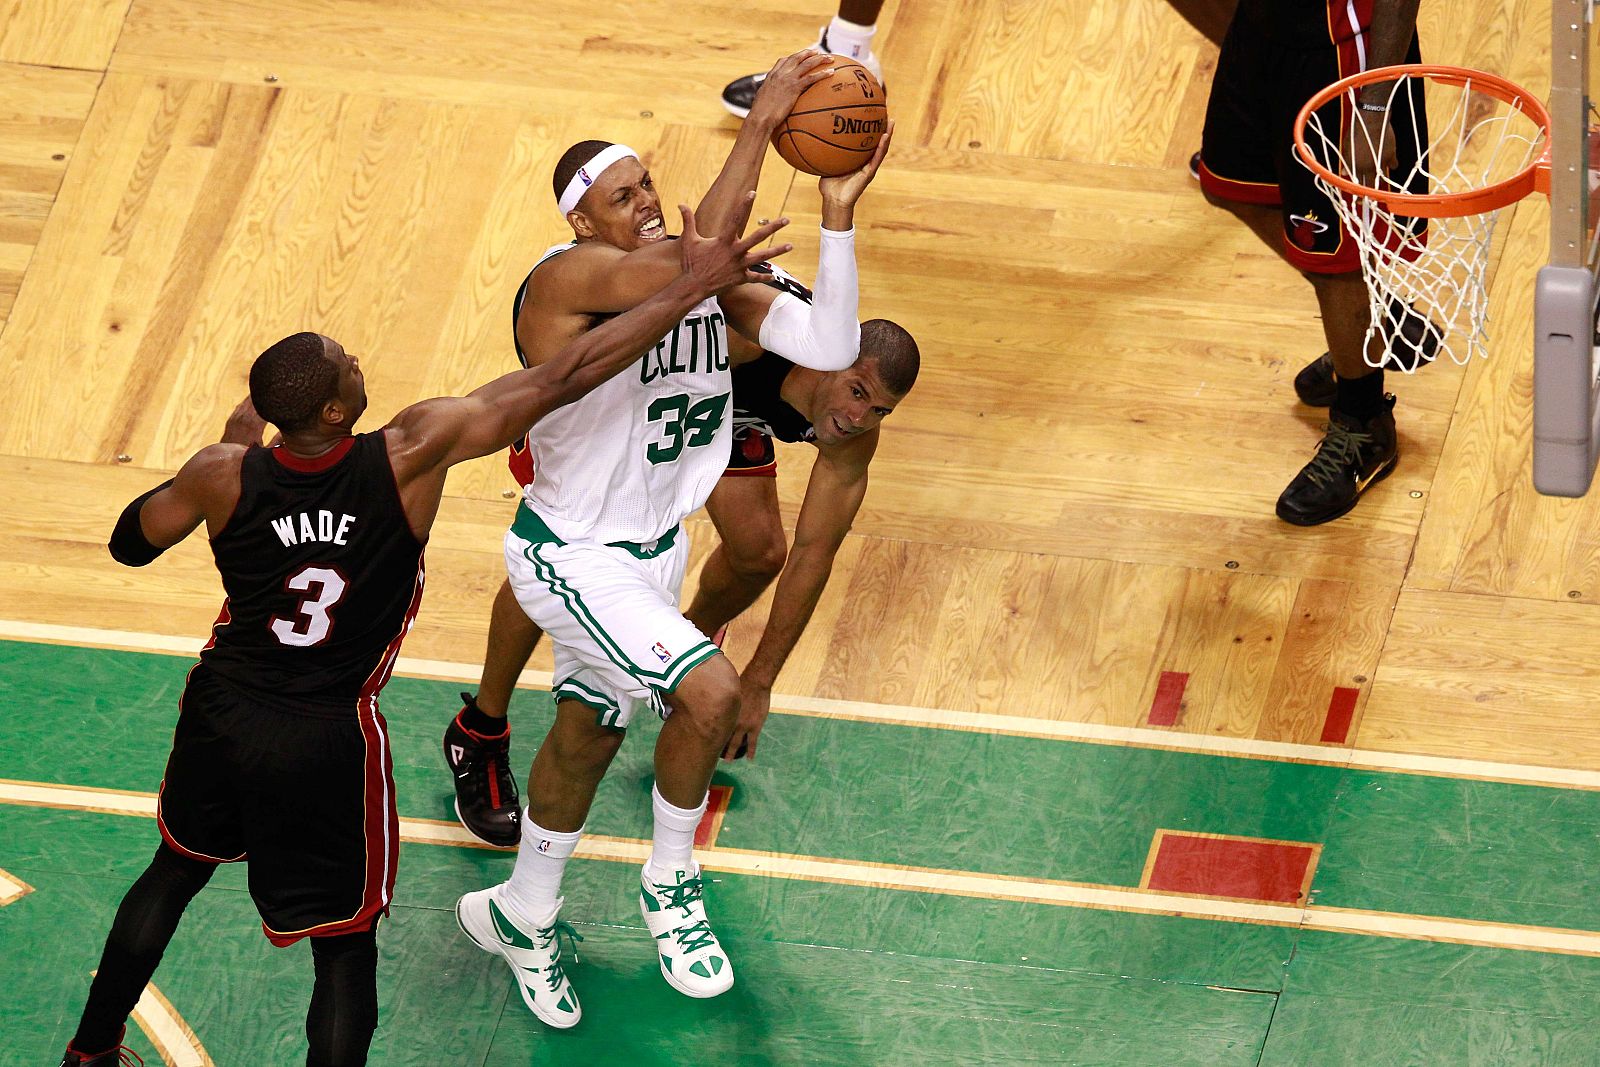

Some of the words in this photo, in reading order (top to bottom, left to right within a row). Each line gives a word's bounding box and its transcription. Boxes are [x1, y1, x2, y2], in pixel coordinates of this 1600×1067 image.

[647, 392, 731, 466] 34
[271, 509, 357, 548] WADE
[271, 566, 346, 647] 3
